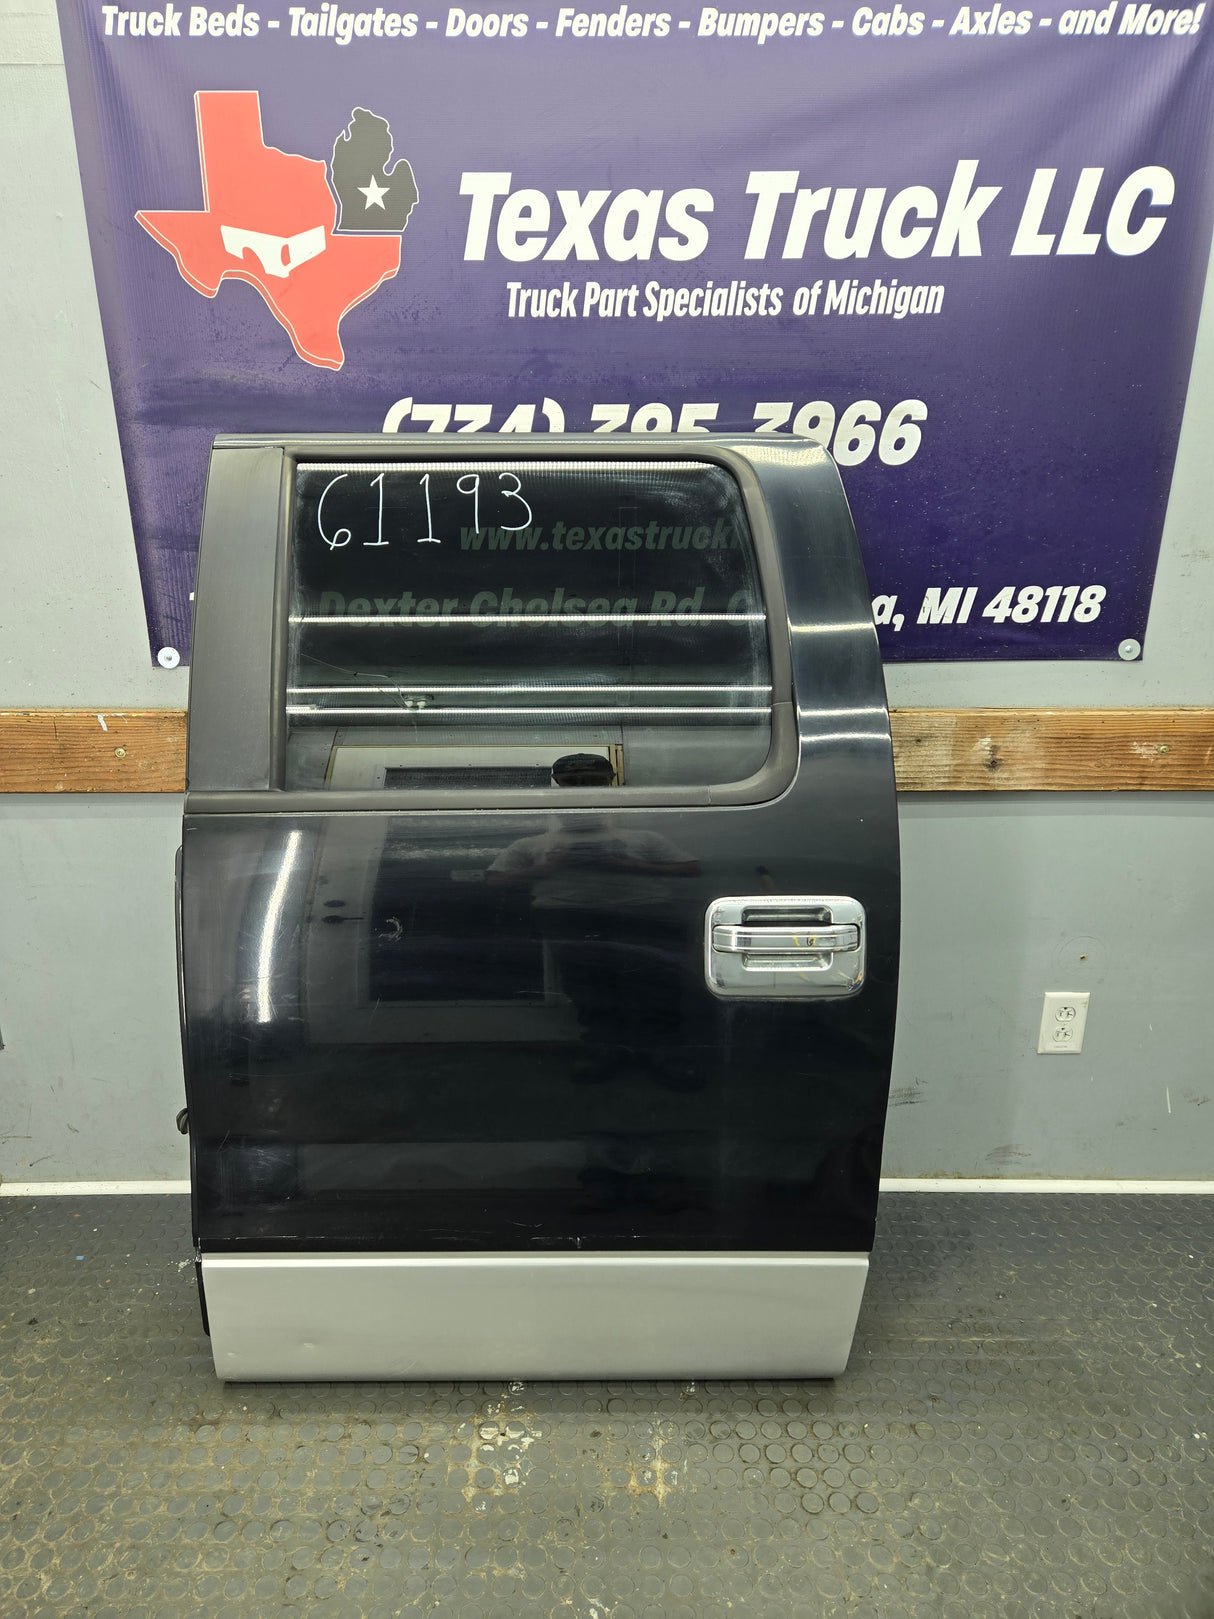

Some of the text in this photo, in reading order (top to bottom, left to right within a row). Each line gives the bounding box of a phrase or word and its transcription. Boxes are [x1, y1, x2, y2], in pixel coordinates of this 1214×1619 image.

[101, 3, 183, 37] Truck
[188, 3, 260, 37] Beds
[288, 2, 419, 46] Tailgates
[445, 7, 530, 38] Doors
[555, 4, 672, 37] Fenders
[697, 7, 826, 45] Bumpers
[851, 3, 926, 36] Cabs
[948, 2, 1034, 36] Axles
[1058, 0, 1119, 35] and
[1117, 2, 1206, 35] More!
[458, 159, 1175, 262] Texas Truck LLC
[506, 278, 945, 322] Truck Part Specialists of Michigan
[317, 472, 533, 551] 61193
[318, 591, 459, 628] Dexter
[469, 587, 638, 628] Chelsea
[916, 586, 979, 624] MI
[981, 584, 1107, 624] 48118
